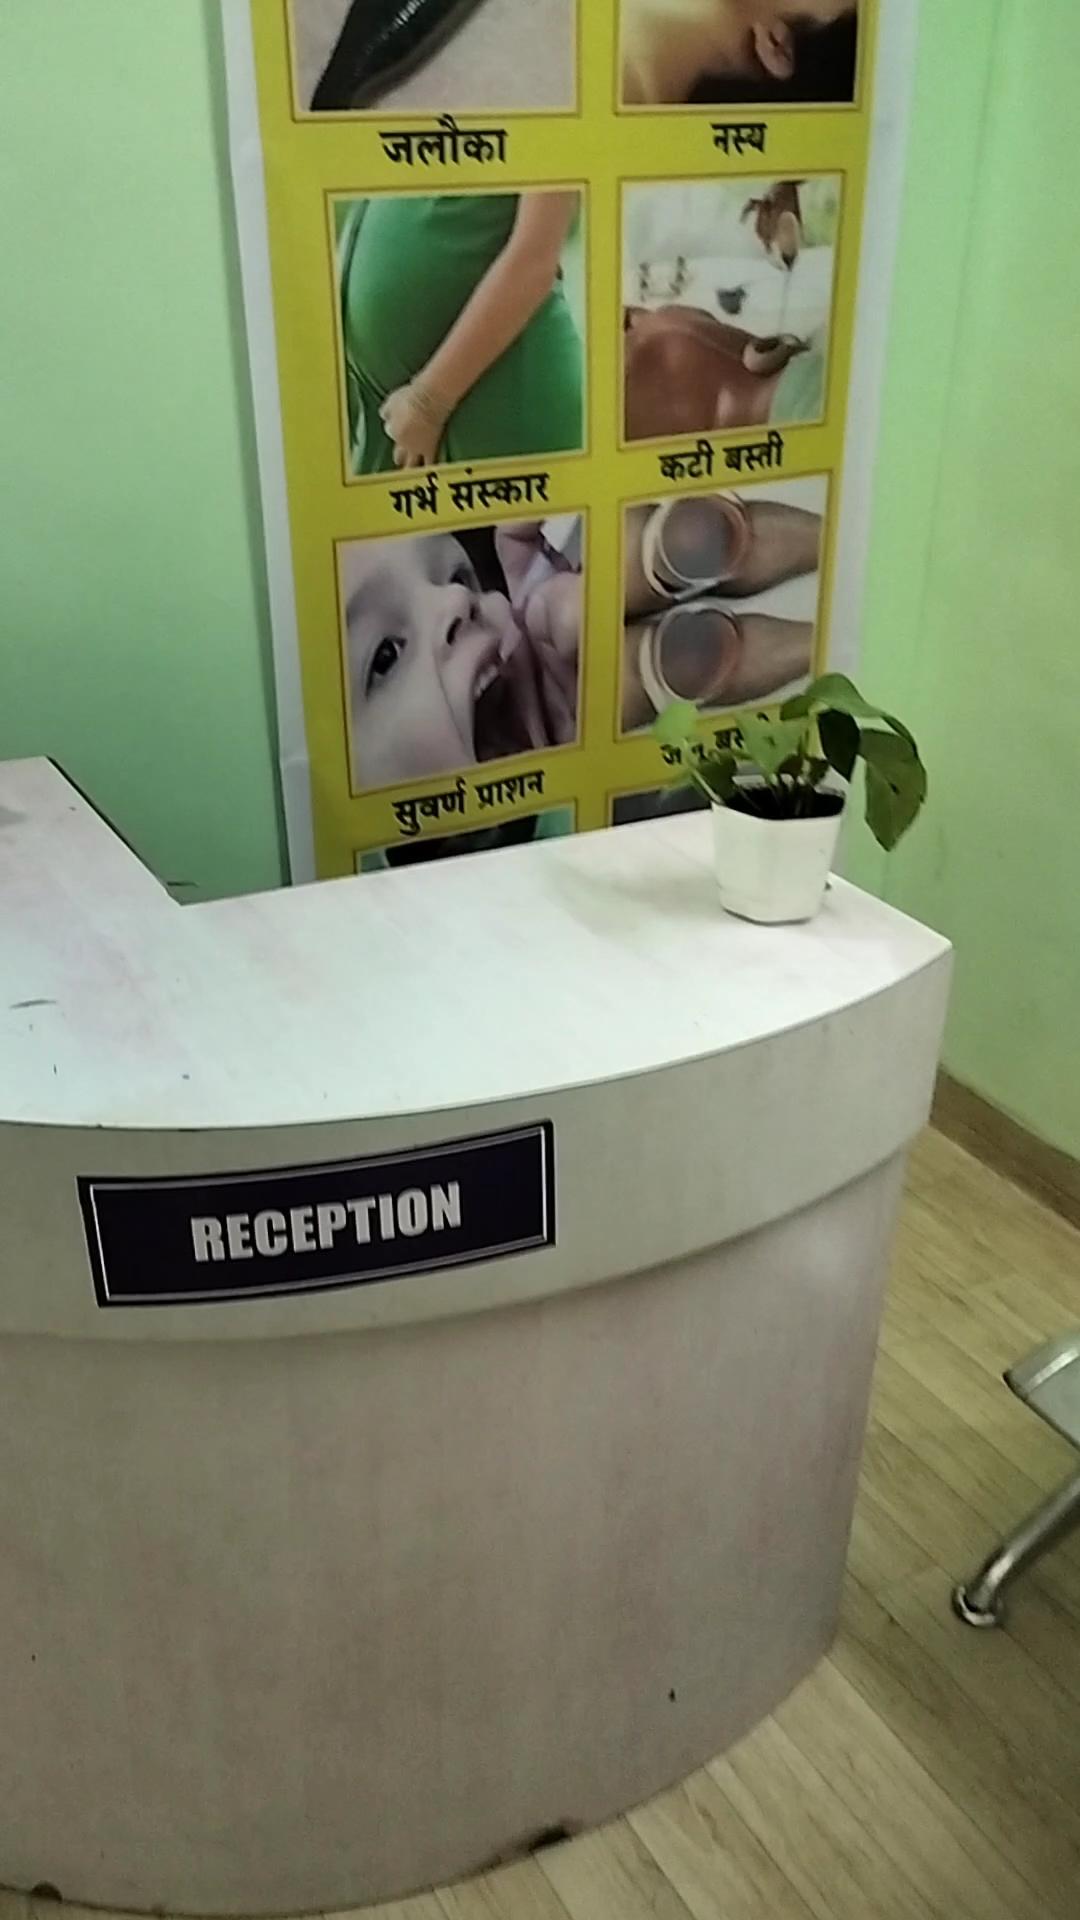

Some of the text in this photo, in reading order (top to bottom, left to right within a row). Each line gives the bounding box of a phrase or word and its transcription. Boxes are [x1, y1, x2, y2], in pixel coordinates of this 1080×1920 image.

[379, 114, 508, 166] जलौका
[710, 122, 768, 154] नस्य
[658, 430, 783, 482] कटी बस्ती
[389, 467, 549, 518] गर्भ संस्कार
[392, 769, 545, 836] सुवर्ण प्राशन
[190, 1181, 462, 1262] RECEPTION
